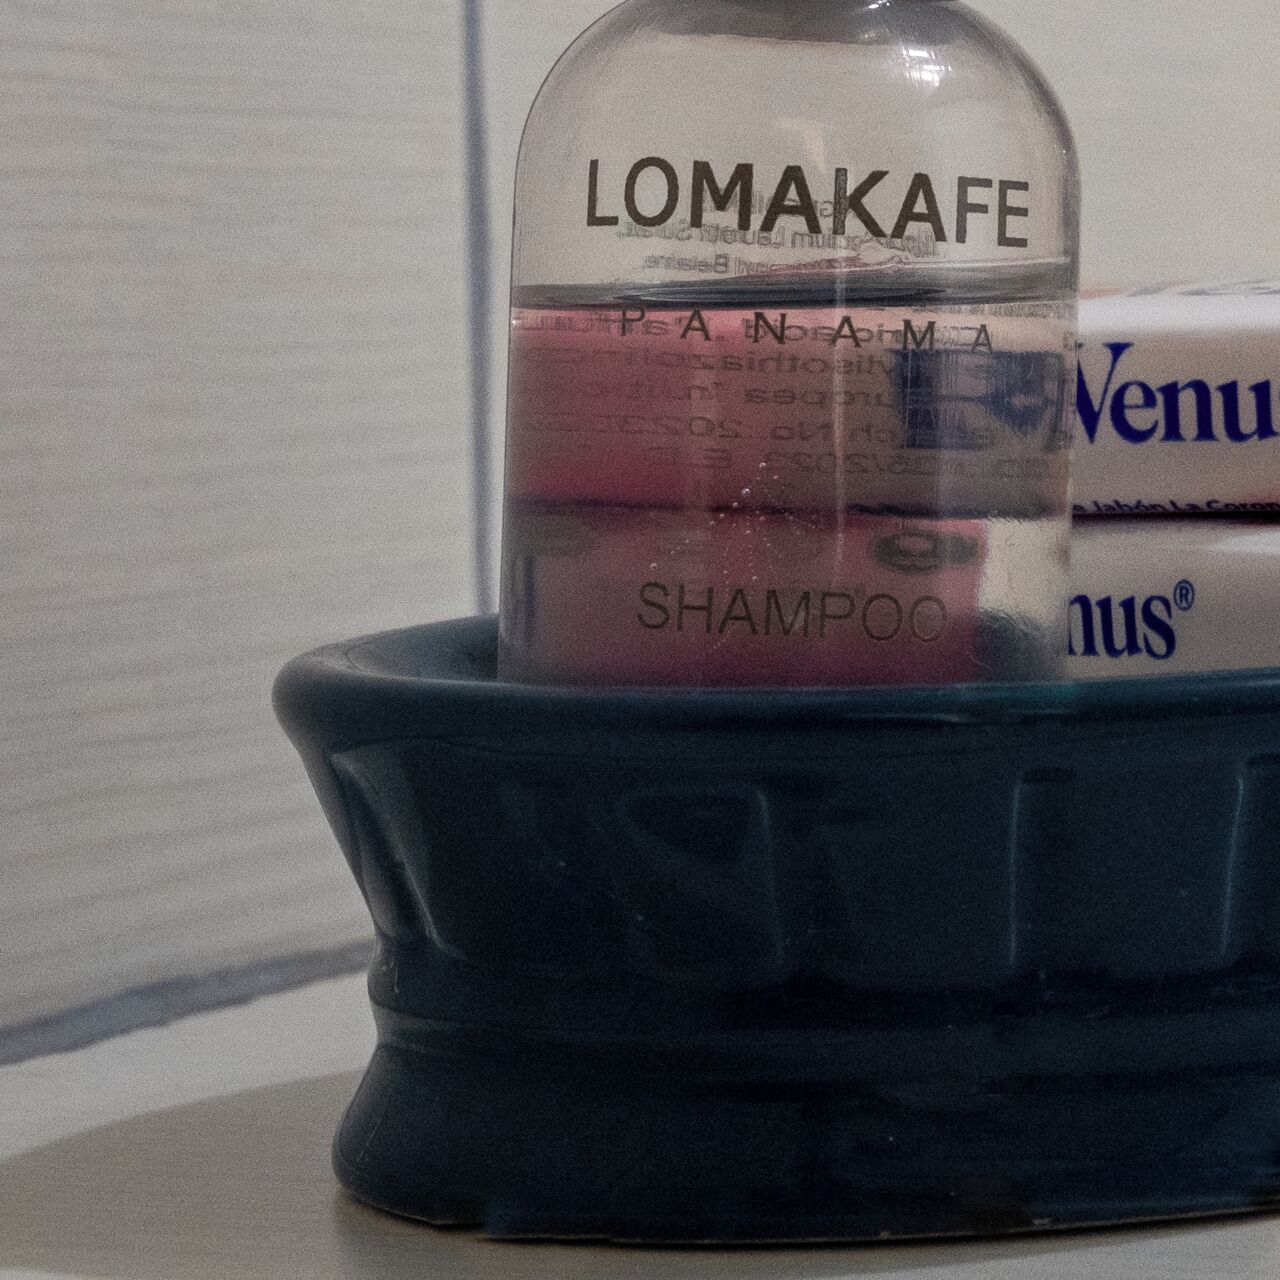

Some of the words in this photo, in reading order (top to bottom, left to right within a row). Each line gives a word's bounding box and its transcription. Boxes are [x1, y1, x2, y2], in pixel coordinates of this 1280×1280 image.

[586, 156, 1029, 248] LOMAKAFE
[619, 307, 994, 353] PANAMA
[637, 582, 946, 642] SHAMPOO
